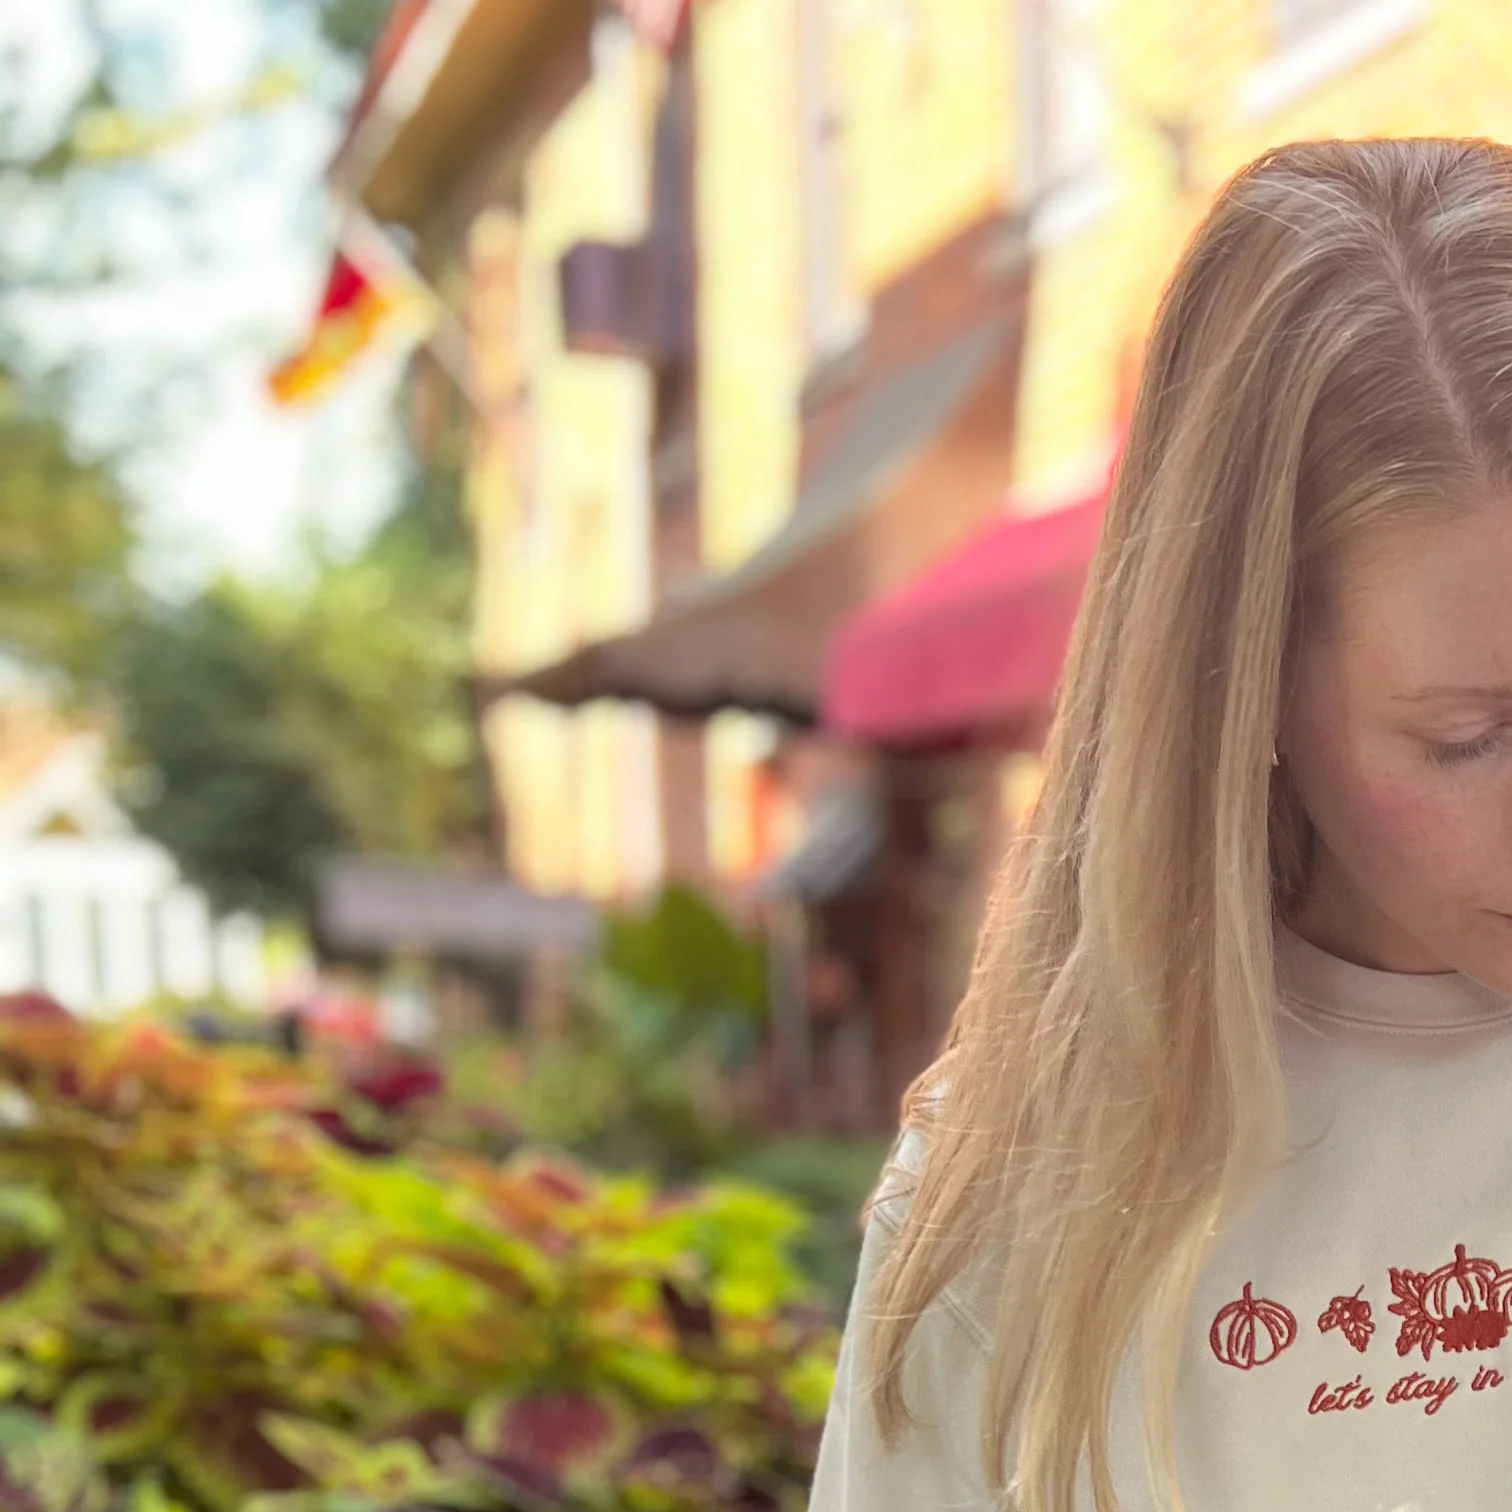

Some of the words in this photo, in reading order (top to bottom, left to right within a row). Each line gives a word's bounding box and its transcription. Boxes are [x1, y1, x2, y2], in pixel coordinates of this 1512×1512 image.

[1307, 1374, 1373, 1416] let's
[1386, 1372, 1458, 1416] stay
[1470, 1366, 1504, 1392] in
